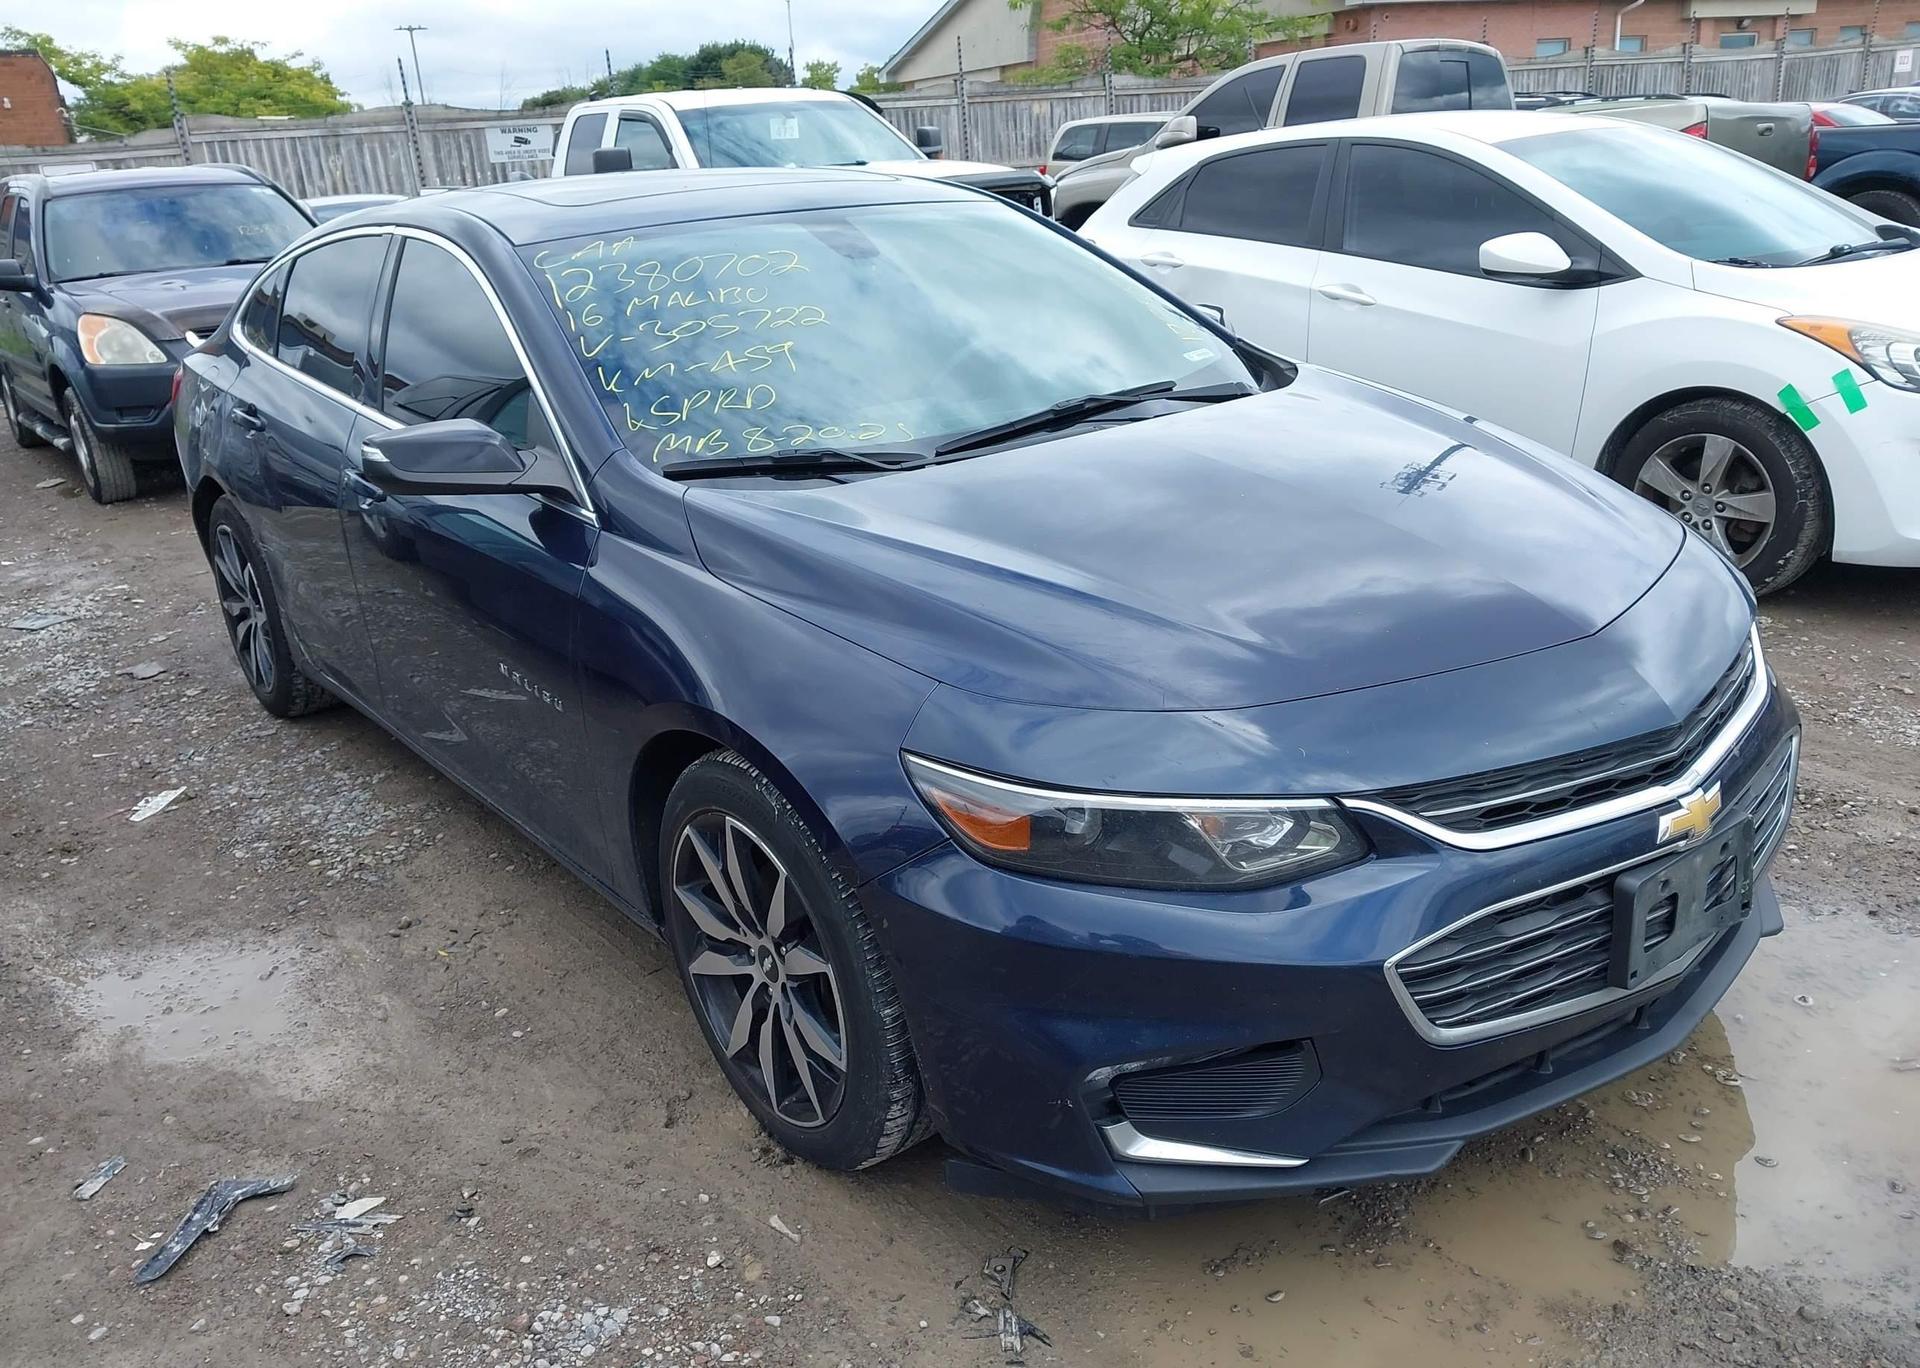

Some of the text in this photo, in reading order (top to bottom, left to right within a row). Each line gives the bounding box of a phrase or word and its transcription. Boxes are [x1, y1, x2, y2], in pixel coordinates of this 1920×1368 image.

[499, 126, 538, 135] WARNING
[545, 249, 810, 310] 12380702
[566, 303, 604, 333] 16
[499, 662, 564, 713] MALIBU
